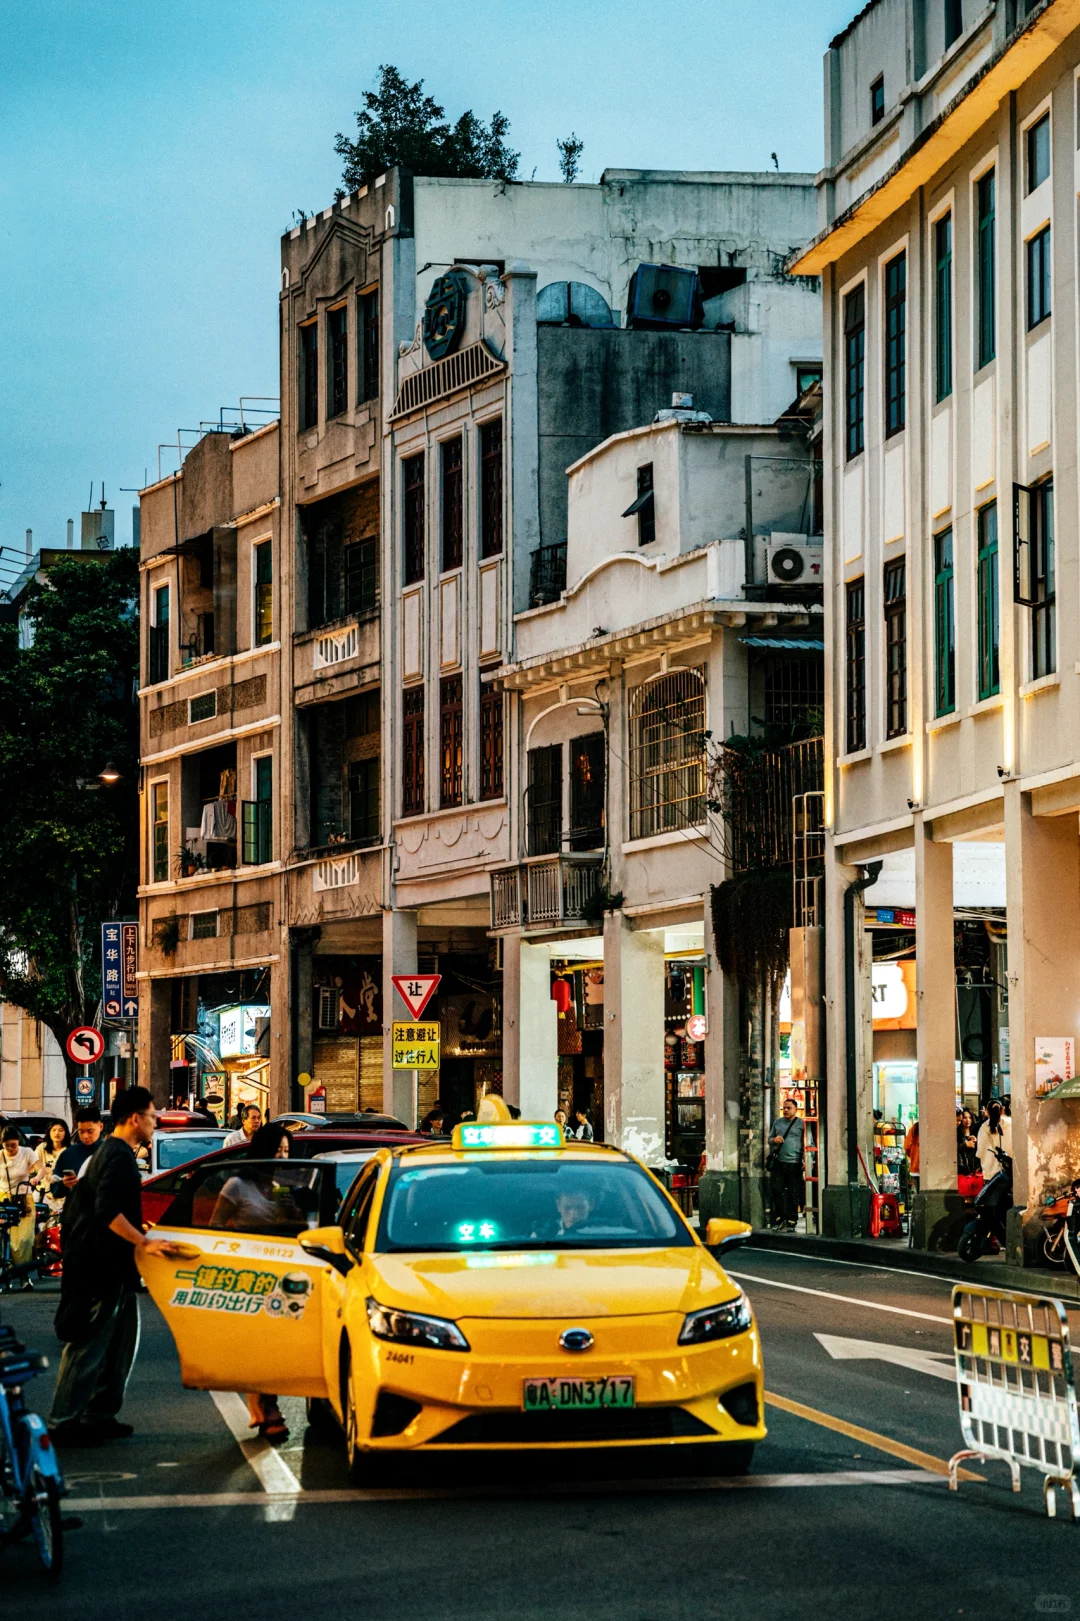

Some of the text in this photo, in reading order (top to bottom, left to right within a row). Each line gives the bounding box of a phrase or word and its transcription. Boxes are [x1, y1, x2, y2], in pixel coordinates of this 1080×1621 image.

[106, 928, 119, 982] 宝华路
[125, 928, 136, 982] 上下九步行街
[407, 981, 423, 997] 让
[394, 1027, 438, 1042] 注意避让
[394, 1049, 437, 1064] 过往行人
[458, 1222, 495, 1241] 空车
[212, 1239, 294, 1258] 广交 96122
[175, 1265, 278, 1295] 一键约黄的
[173, 1290, 264, 1313] 用如约出行
